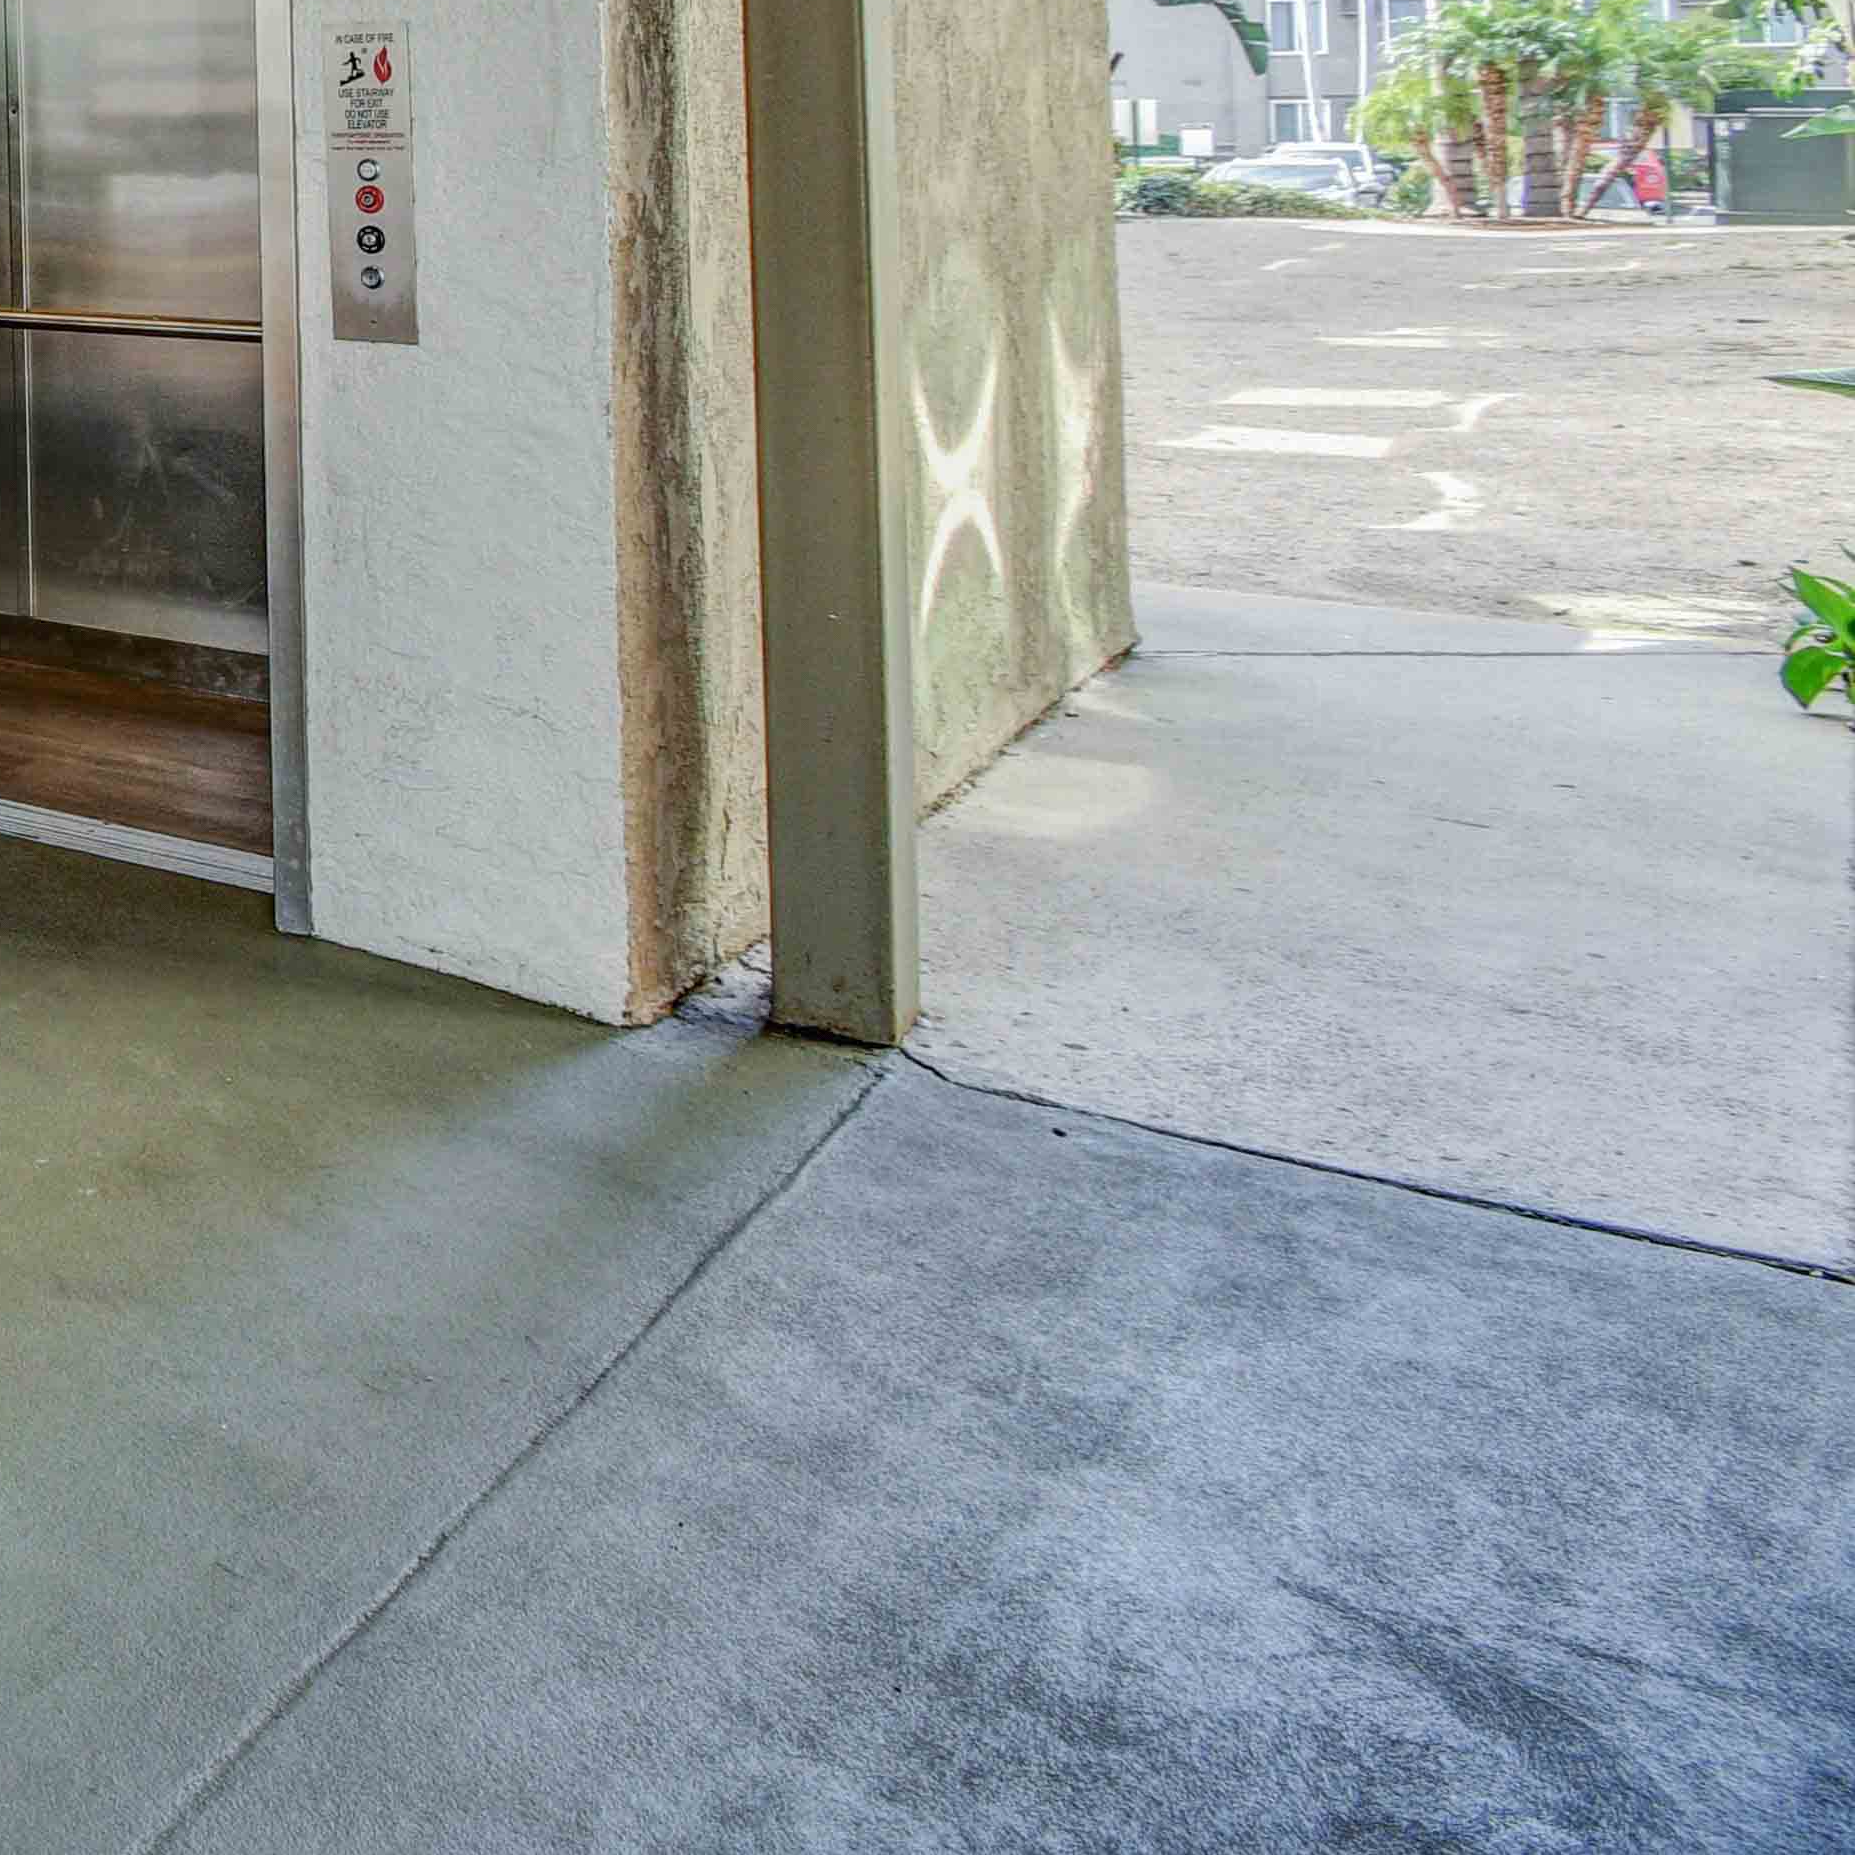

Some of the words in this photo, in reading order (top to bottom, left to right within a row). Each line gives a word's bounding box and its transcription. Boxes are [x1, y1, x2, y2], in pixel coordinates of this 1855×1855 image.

[344, 33, 364, 44] CASE
[365, 32, 376, 43] OF
[377, 32, 394, 43] FIRE
[338, 88, 356, 98] USE
[357, 87, 394, 97] STAIRWAY
[350, 98, 367, 108] FOR
[368, 98, 384, 108] EXIT
[344, 109, 356, 120] DO
[357, 109, 373, 119] NOT
[347, 119, 387, 129] ELEVATOR
